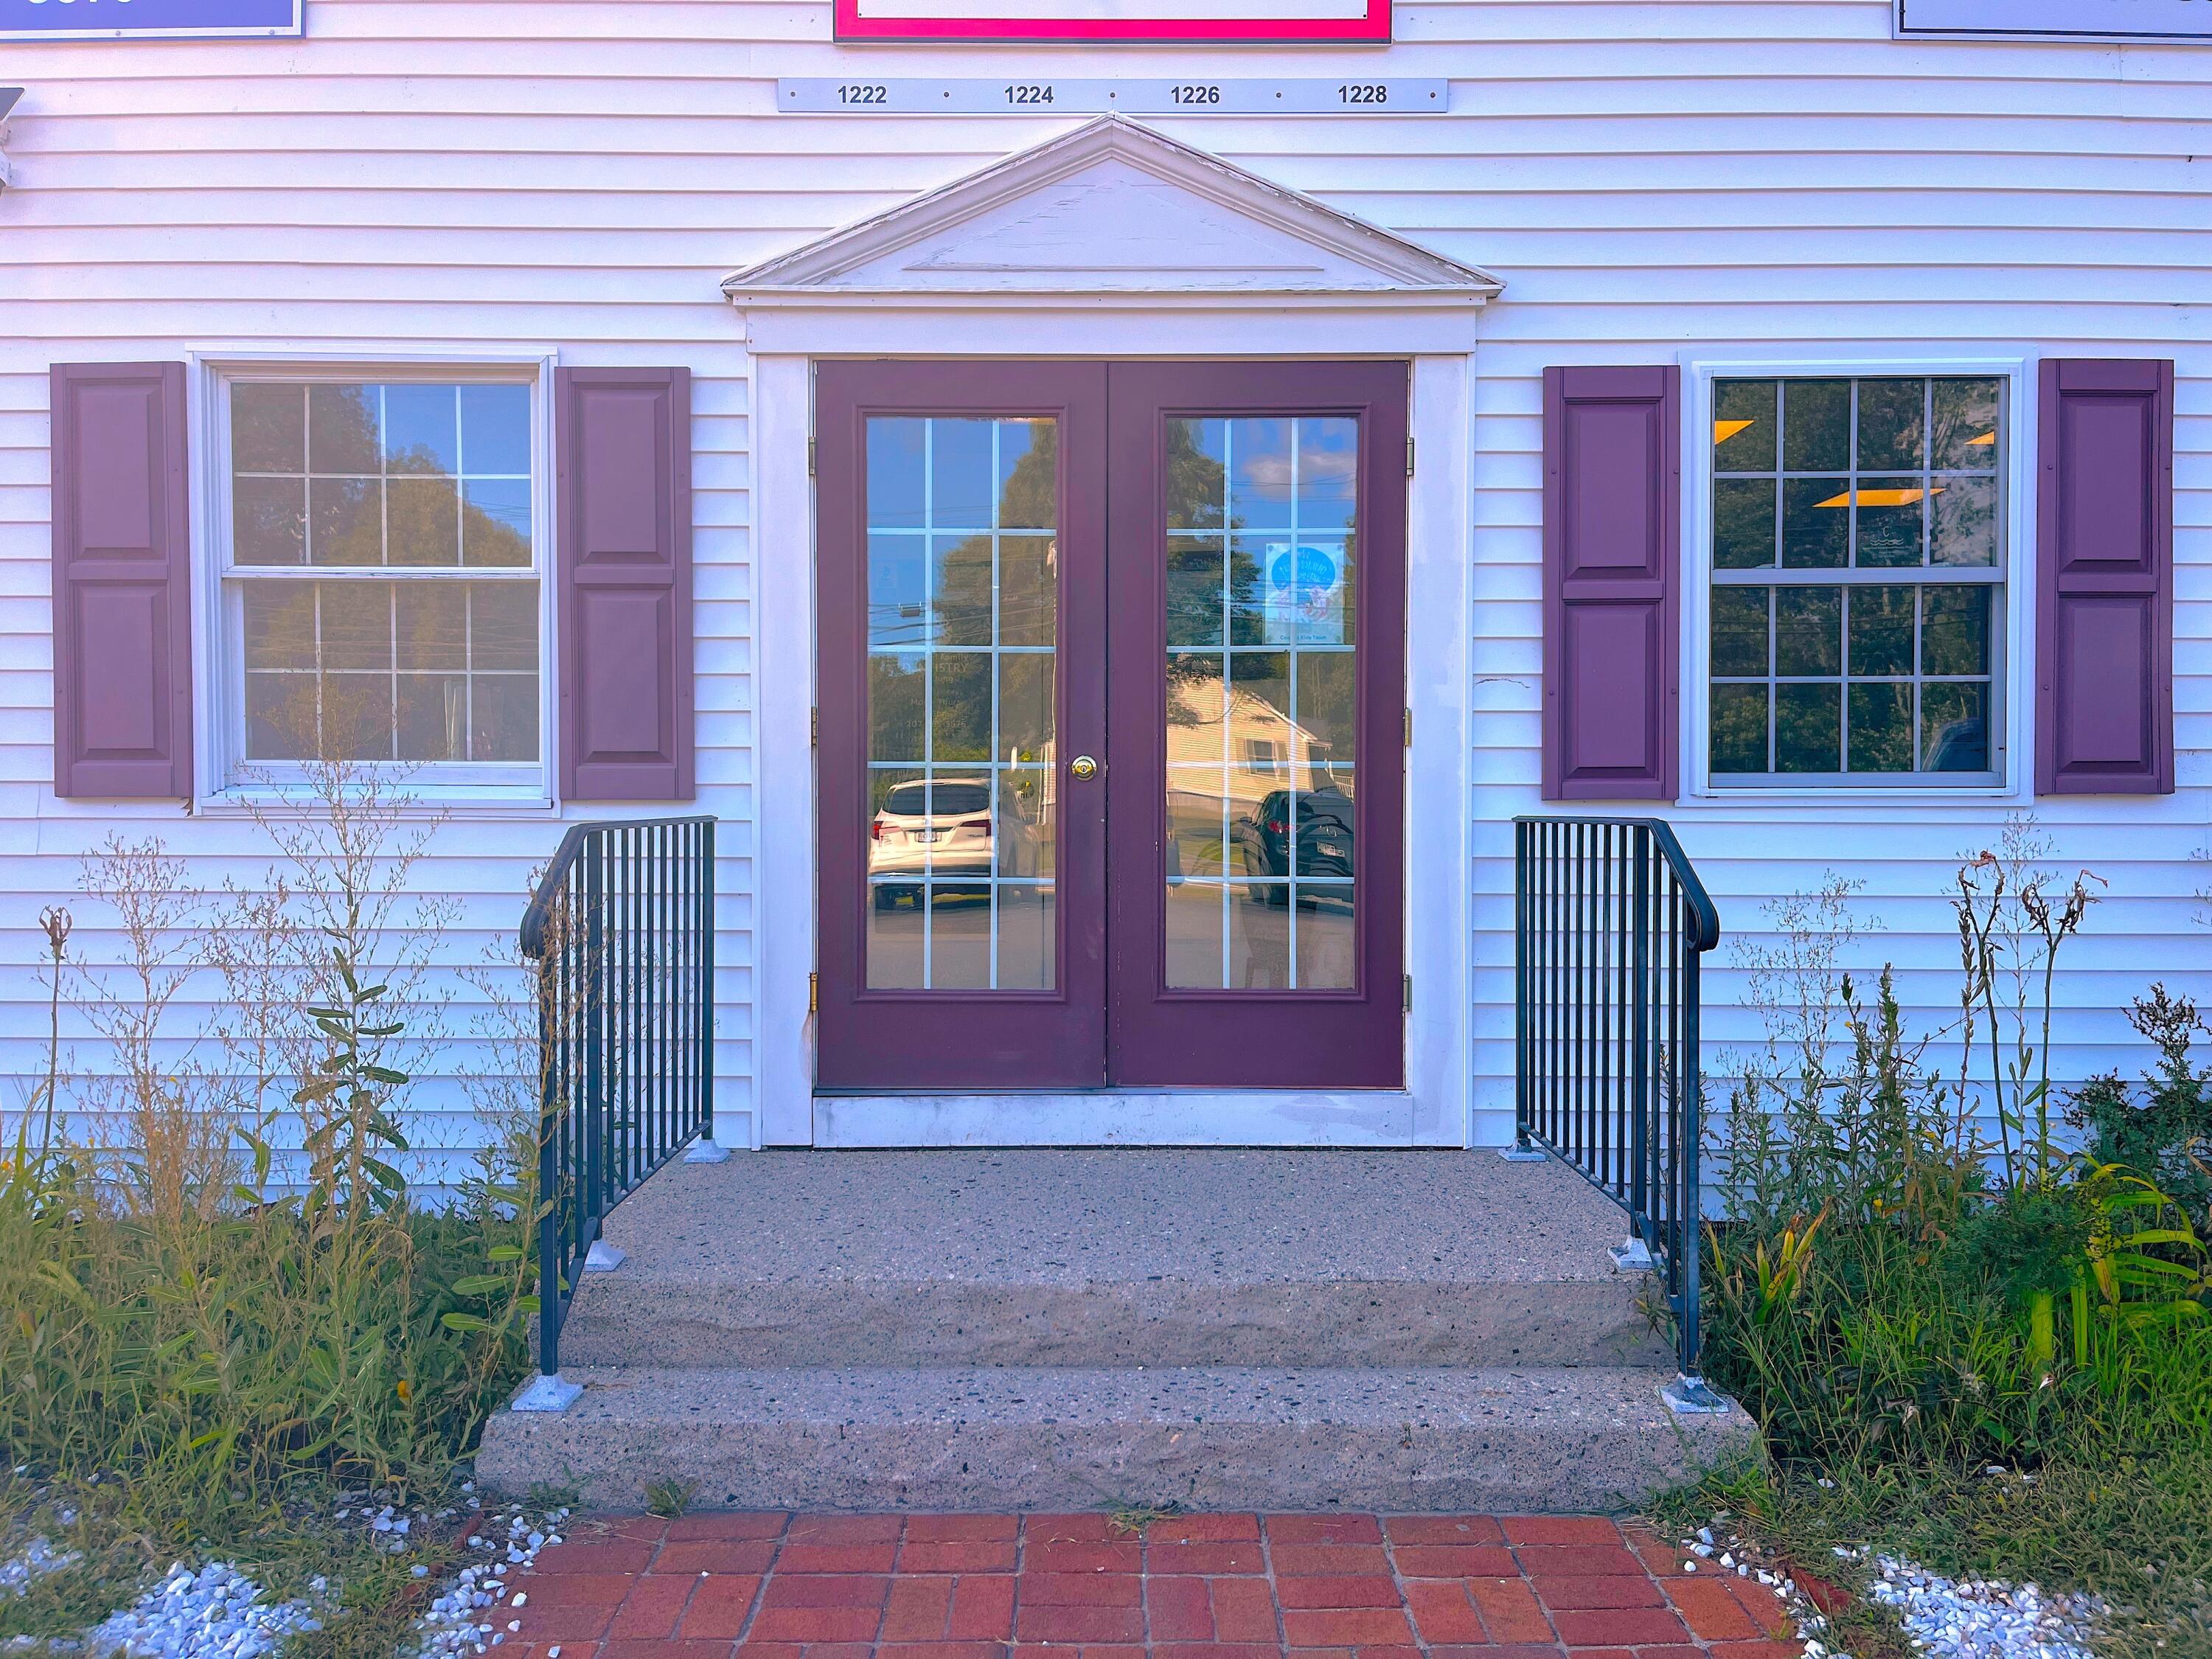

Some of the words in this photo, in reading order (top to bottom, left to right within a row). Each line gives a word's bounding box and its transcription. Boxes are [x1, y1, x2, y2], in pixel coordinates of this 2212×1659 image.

[838, 86, 886, 104] 1222
[1004, 86, 1054, 103] 1224
[1171, 86, 1220, 104] 1226
[1338, 85, 1387, 103] 1228
